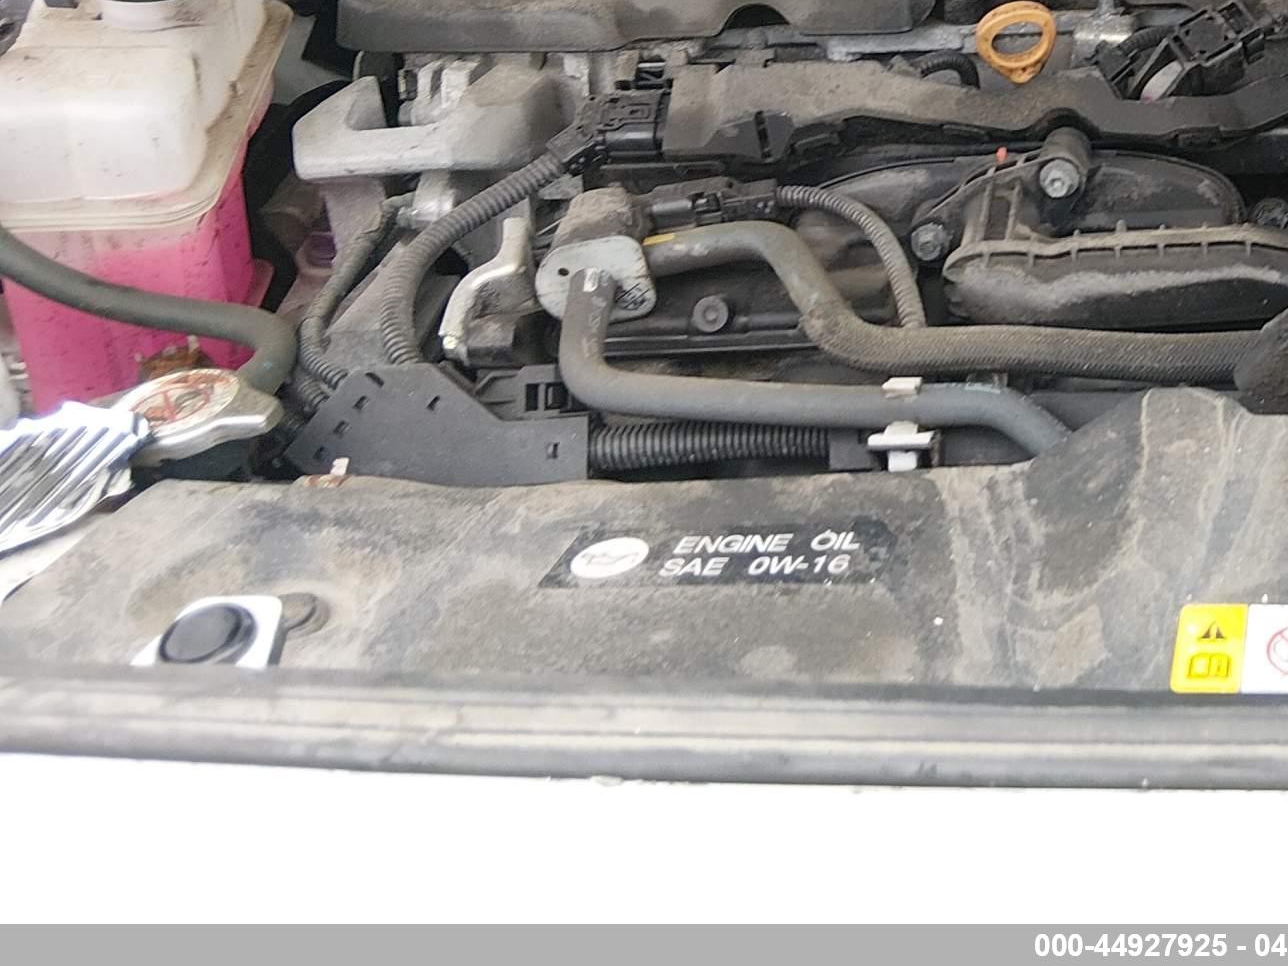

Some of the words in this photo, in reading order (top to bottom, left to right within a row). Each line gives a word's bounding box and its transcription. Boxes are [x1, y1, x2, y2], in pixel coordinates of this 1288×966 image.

[673, 533, 794, 554] ENGINE
[810, 530, 861, 552] OIL
[658, 556, 729, 577] SAE
[747, 553, 851, 576] 0W-16
